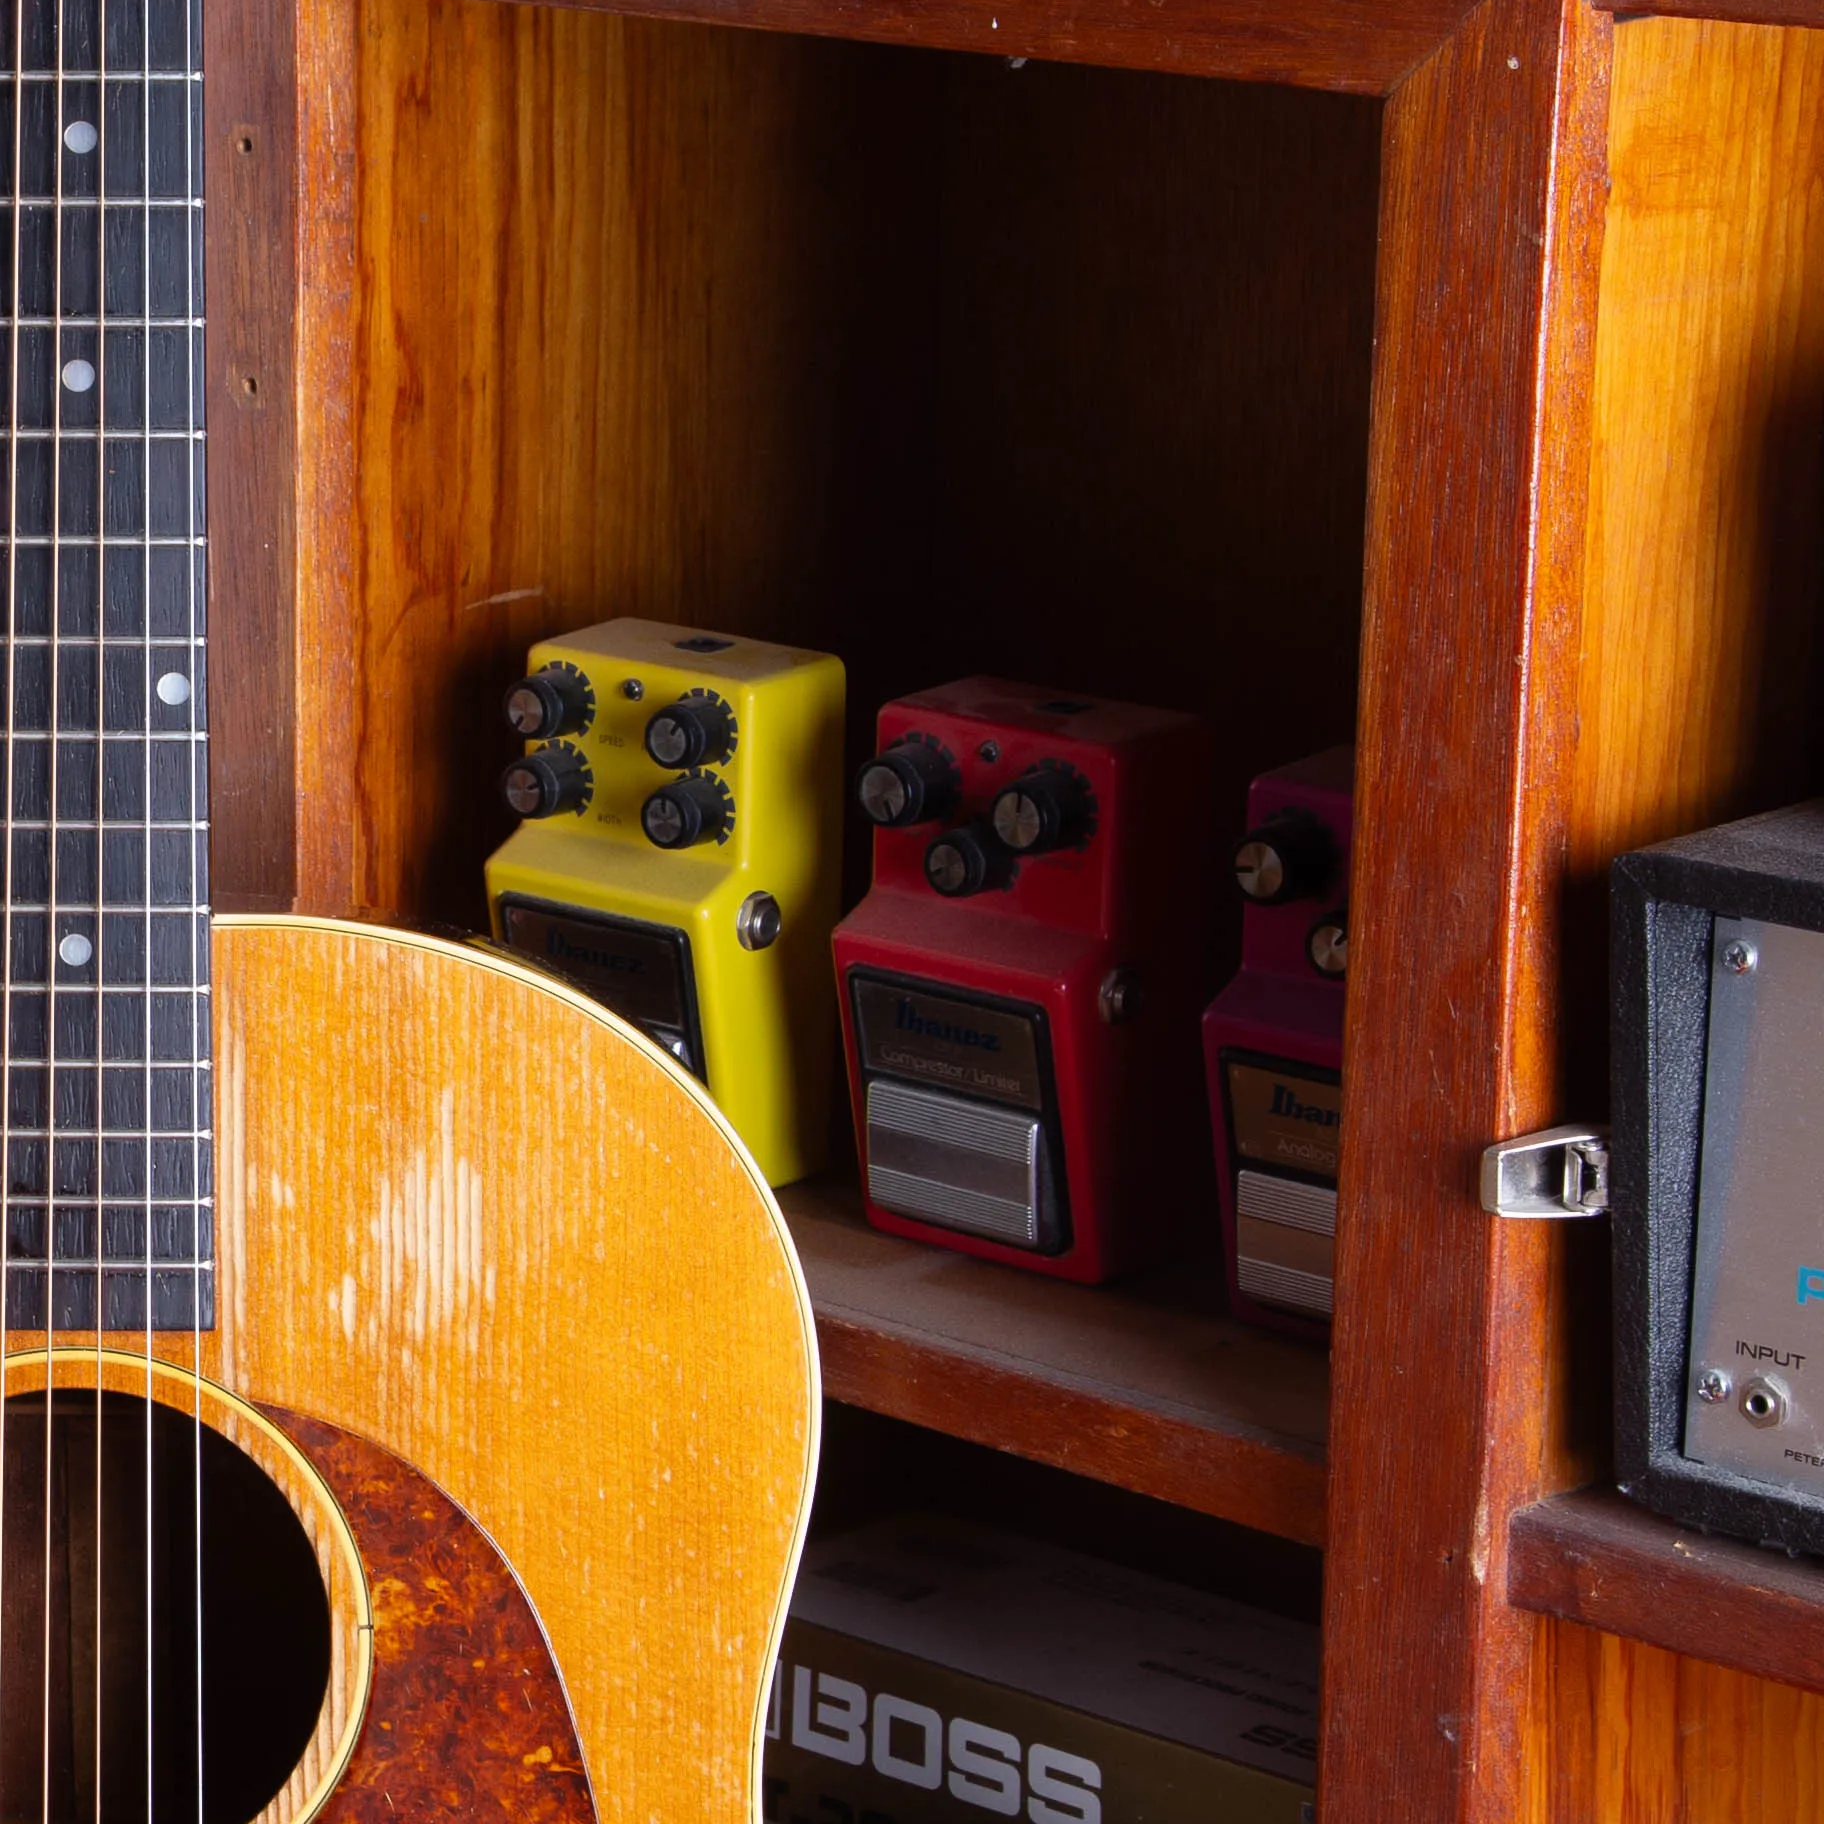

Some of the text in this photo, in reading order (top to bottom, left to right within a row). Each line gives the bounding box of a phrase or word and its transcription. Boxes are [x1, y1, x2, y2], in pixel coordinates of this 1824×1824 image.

[544, 927, 645, 974] Ibanez
[895, 997, 1001, 1052] Ibanez
[1735, 1339, 1807, 1371] INPUT
